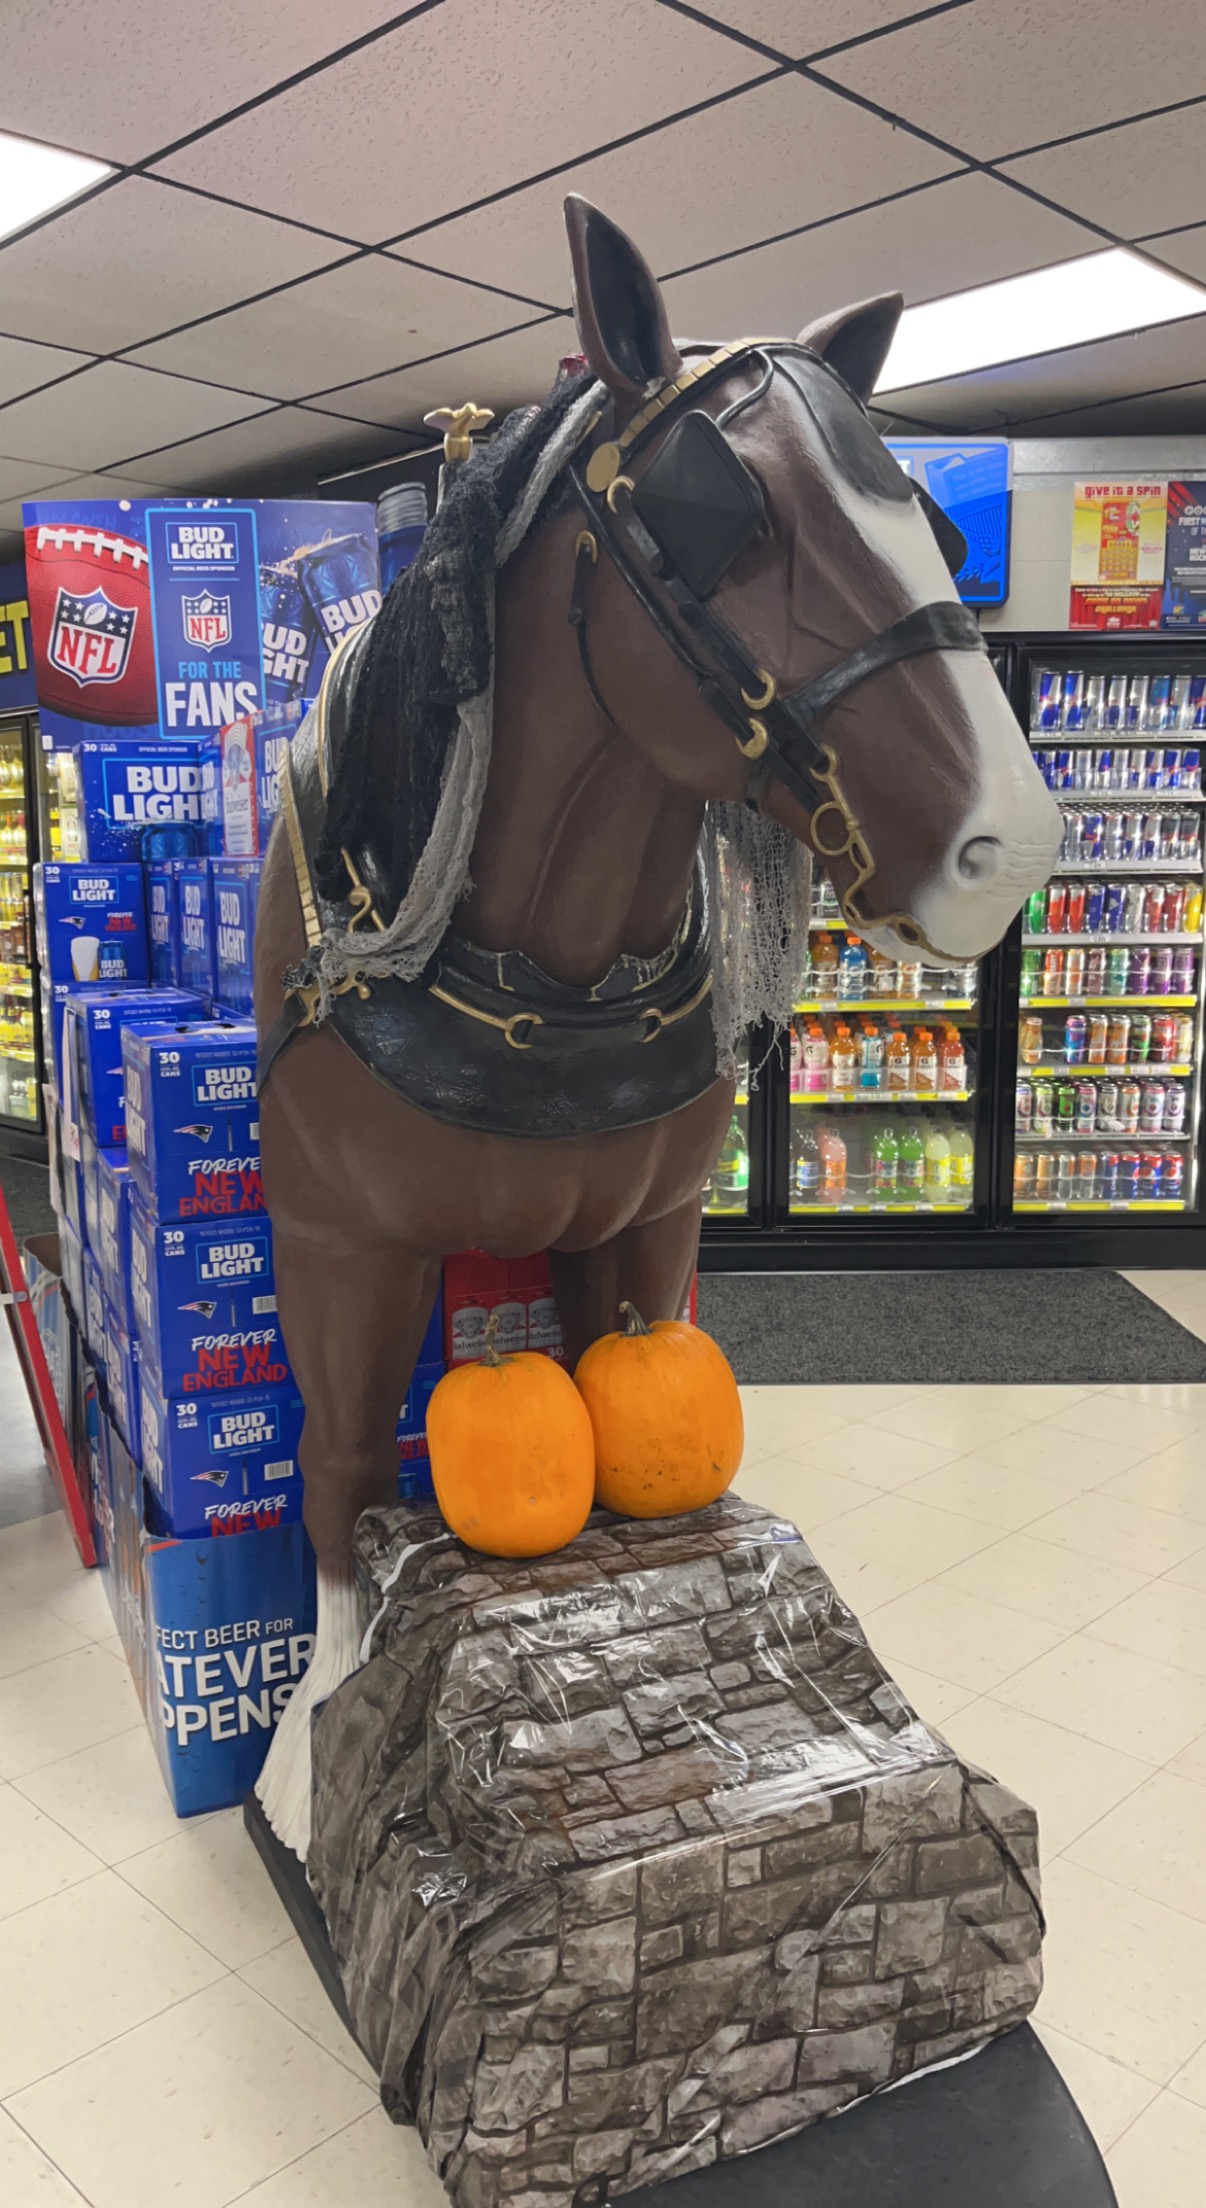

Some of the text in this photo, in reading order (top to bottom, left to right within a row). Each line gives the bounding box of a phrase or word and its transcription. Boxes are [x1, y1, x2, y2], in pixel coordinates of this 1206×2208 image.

[1084, 486, 1161, 499] give it a spin
[178, 526, 225, 544] BUD
[171, 543, 235, 560] LIGHT
[321, 589, 383, 633] BUD
[189, 617, 226, 642] NFL
[260, 622, 307, 656] UD
[57, 625, 117, 675] NFL
[178, 661, 241, 679] FOR THE
[165, 681, 258, 728] FANS
[83, 743, 98, 752] 30
[126, 766, 200, 793] BUD
[45, 866, 60, 875] 30
[78, 879, 109, 890] BUD
[72, 889, 116, 901] LIGHT
[219, 891, 240, 926] BUD
[217, 925, 246, 964] LIGHT
[99, 968, 128, 978] LIGHT
[101, 959, 125, 969] BUD
[54, 985, 69, 994] 30
[93, 1009, 111, 1019] 30
[158, 1051, 180, 1064] 30
[160, 1070, 181, 1078] CANS
[204, 1066, 252, 1085] BUD
[197, 1082, 257, 1102] LIGHT
[195, 1171, 264, 1197] NEW
[163, 1230, 185, 1244] 30
[164, 1249, 186, 1257] CANS
[208, 1242, 255, 1263] BUD
[201, 1256, 265, 1280] LIGHT
[191, 1328, 278, 1352] FOREVER
[197, 1342, 272, 1372] NEW
[547, 1346, 564, 1358] 30
[182, 1363, 288, 1393] ENGLAND
[176, 1402, 198, 1416] 30
[177, 1421, 198, 1429] CANS
[220, 1411, 267, 1433] BUD
[213, 1424, 275, 1450] LIGHT
[204, 1494, 288, 1520] FOREVER
[211, 1508, 282, 1538] NEW
[204, 1619, 261, 1649] BEER
[265, 1617, 294, 1635] FOR
